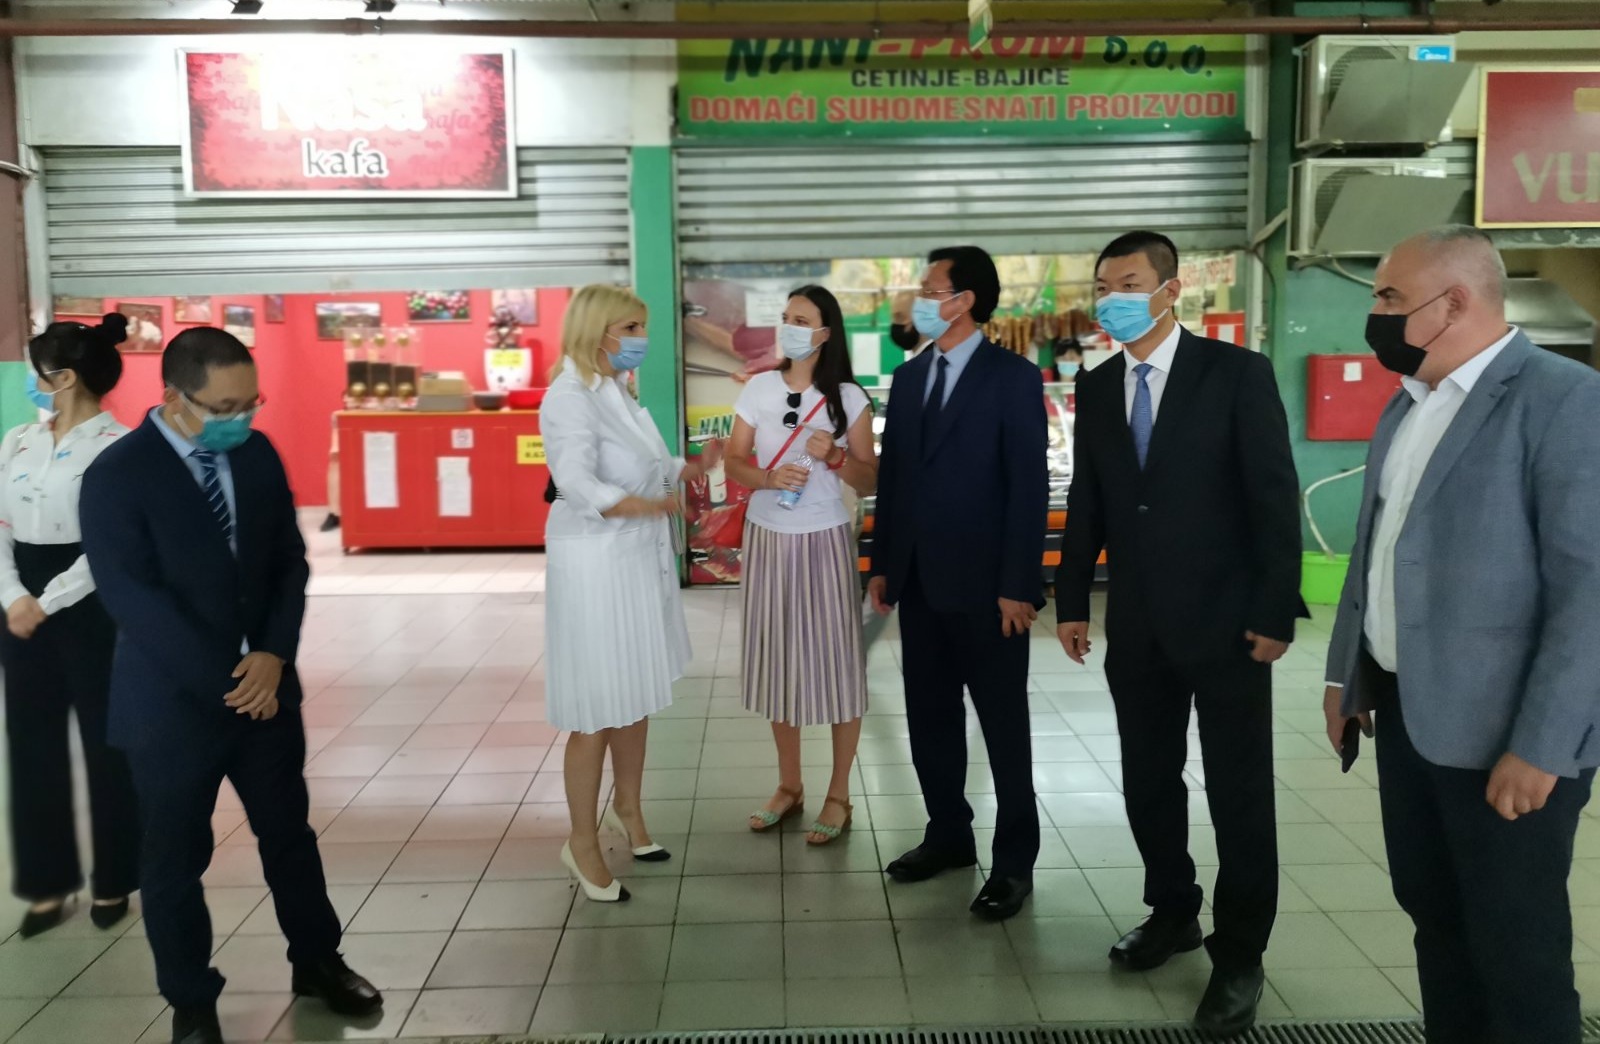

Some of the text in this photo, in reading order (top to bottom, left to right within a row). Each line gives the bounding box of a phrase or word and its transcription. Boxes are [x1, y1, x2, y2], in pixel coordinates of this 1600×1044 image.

[851, 68, 1070, 88] CETINJE-BAJICE
[689, 90, 1237, 123] DOMAĆI SUHOMESNATI PROIZVODI
[304, 139, 386, 177] kafa
[699, 414, 733, 439] NAN
